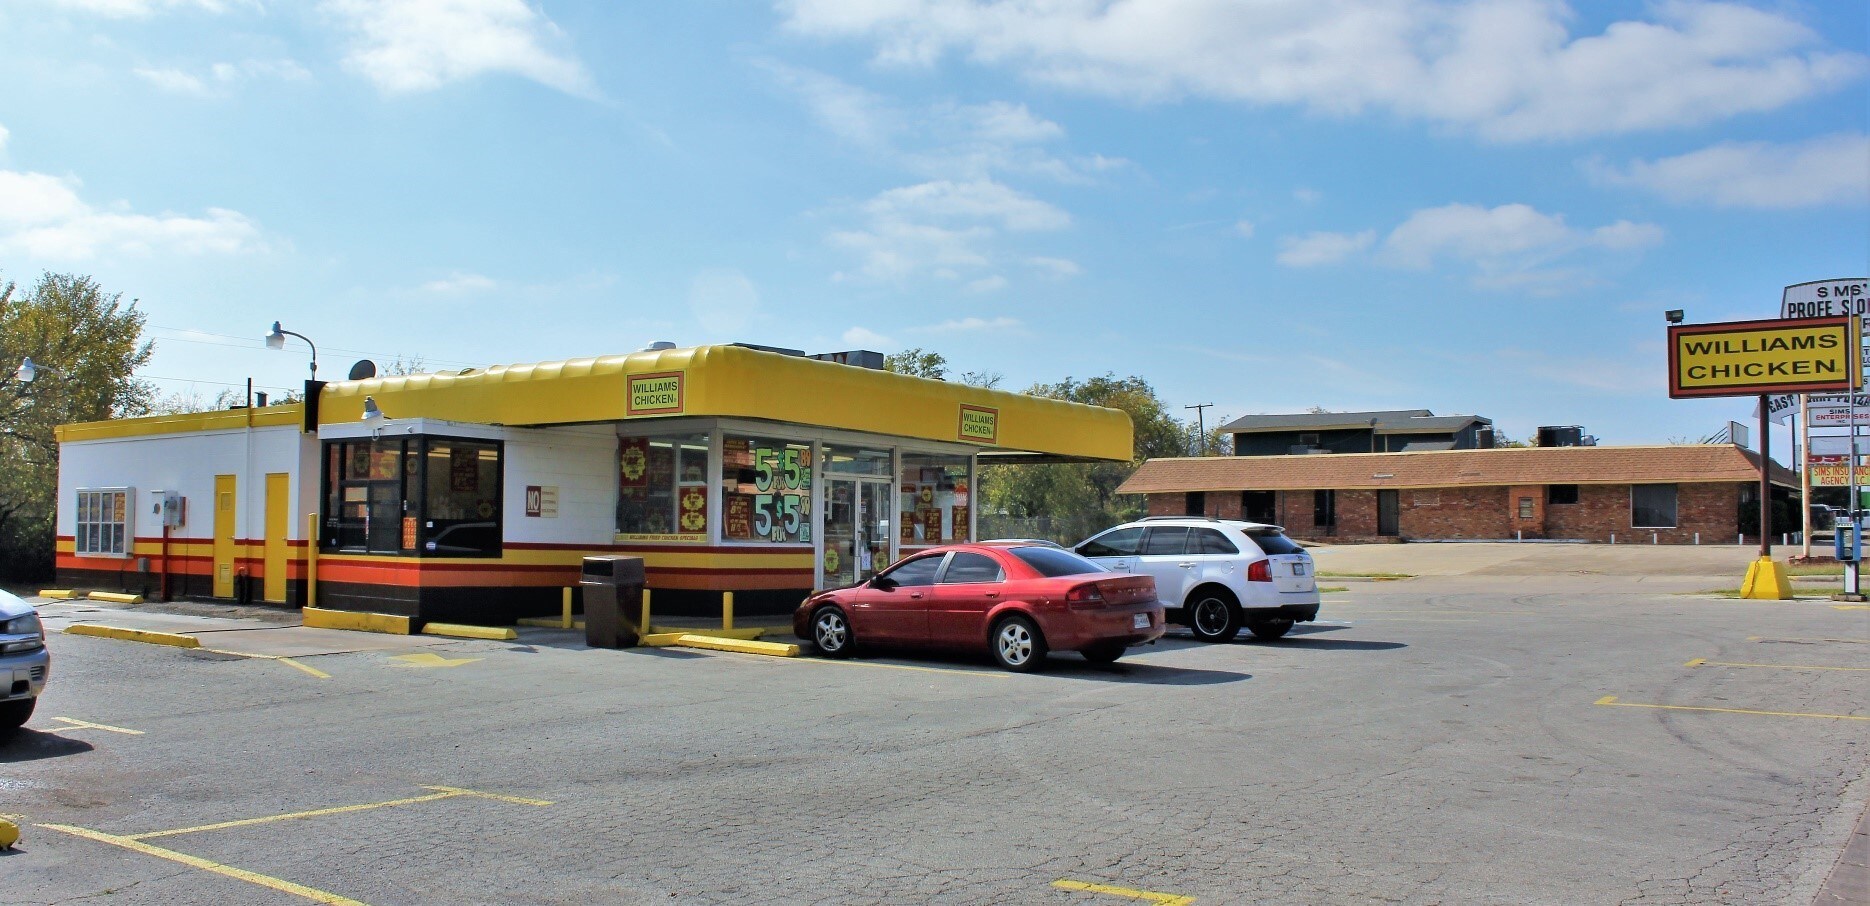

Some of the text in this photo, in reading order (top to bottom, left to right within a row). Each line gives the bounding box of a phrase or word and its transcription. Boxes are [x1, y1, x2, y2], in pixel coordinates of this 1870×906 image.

[1684, 333, 1838, 356] WILLIAMS
[1686, 358, 1836, 380] CHICKEN
[632, 381, 678, 394] WILLIAMS
[634, 393, 674, 406] CHICKEN
[1768, 393, 1794, 414] EAST
[963, 412, 994, 426] WILLIAMS
[1815, 413, 1870, 421] ENTERPRSES
[963, 423, 991, 436] CHICKEN
[755, 447, 773, 493] 5
[1814, 466, 1870, 476] SIMS INSUANC
[1820, 476, 1850, 486] AGENCY
[527, 490, 540, 511] NO
[755, 493, 773, 537] 5
